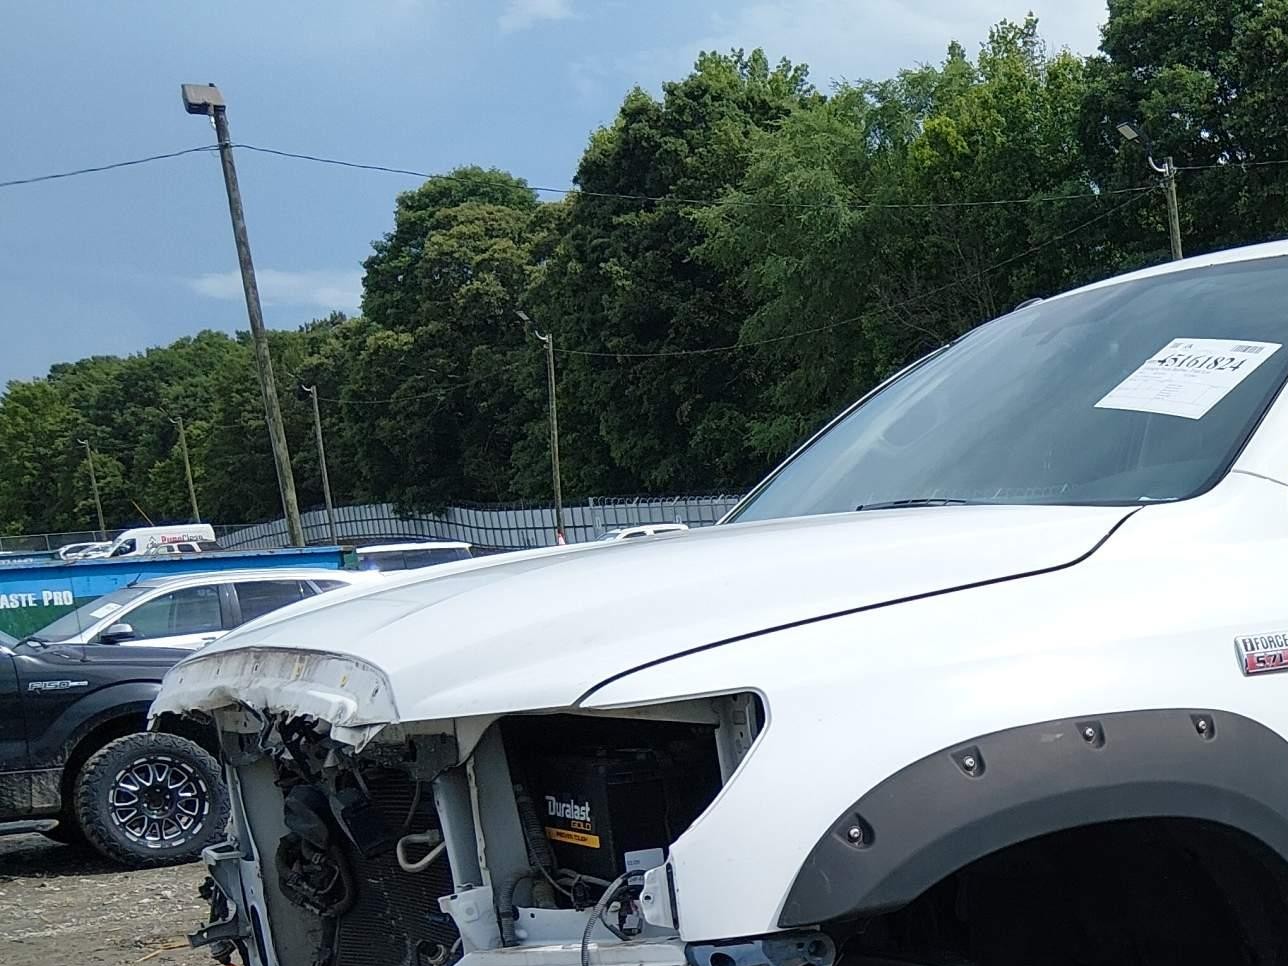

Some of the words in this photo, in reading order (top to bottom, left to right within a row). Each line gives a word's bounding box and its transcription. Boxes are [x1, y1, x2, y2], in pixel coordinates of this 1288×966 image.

[1157, 353, 1248, 372] 45161824
[0, 593, 38, 609] ASTE
[41, 590, 74, 607] PRO
[545, 795, 591, 822] Duralast
[570, 820, 592, 831] GOLD
